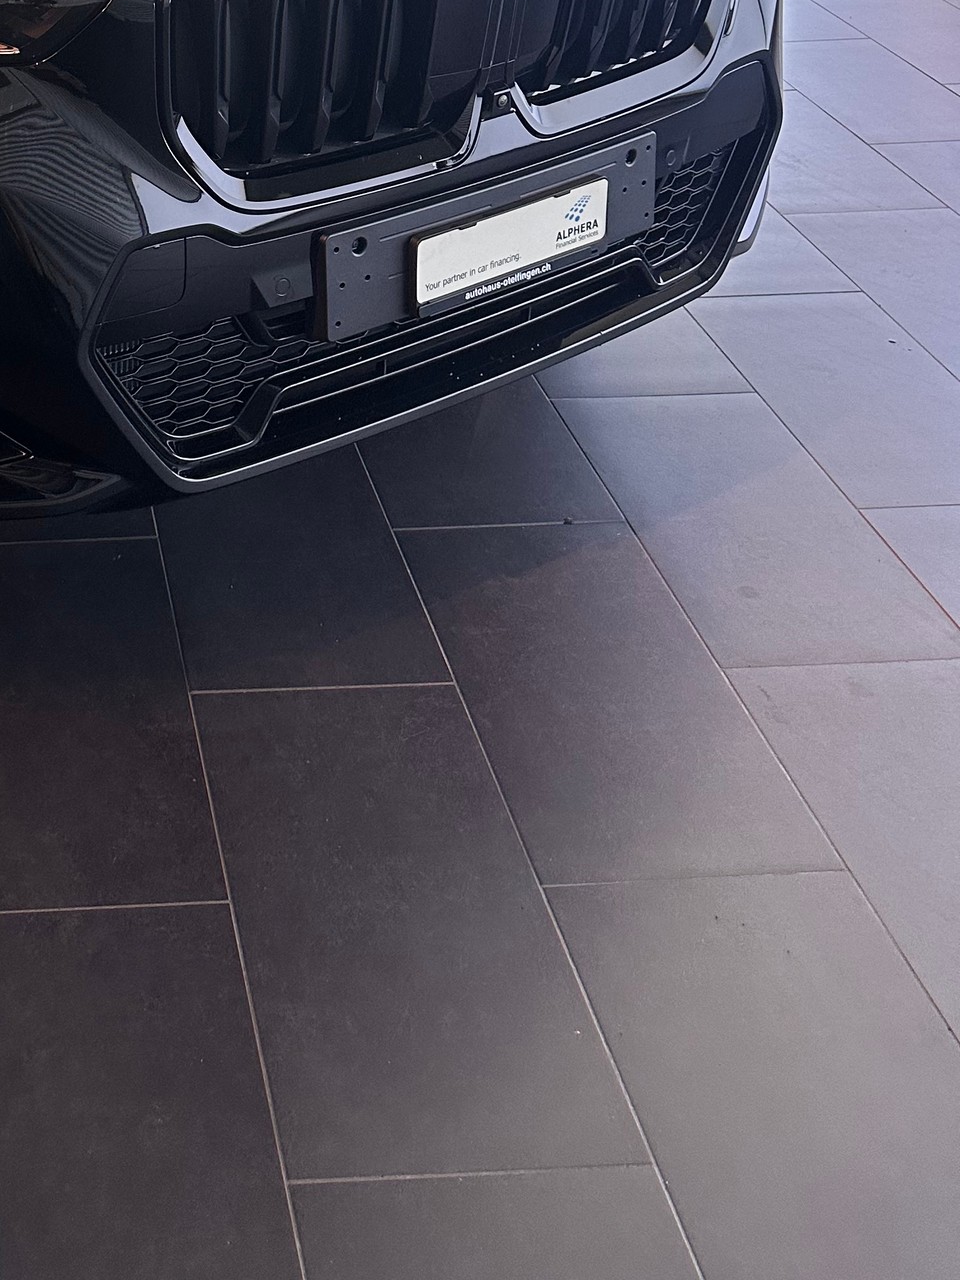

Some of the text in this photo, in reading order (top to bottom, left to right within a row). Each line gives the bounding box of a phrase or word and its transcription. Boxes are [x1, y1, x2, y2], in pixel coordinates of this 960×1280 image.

[555, 230, 599, 249] Financial Services
[556, 219, 599, 242] ALPHERA
[425, 253, 522, 292] Your partner in car financing.
[464, 262, 552, 300] autohaus-otelfingen.ch
